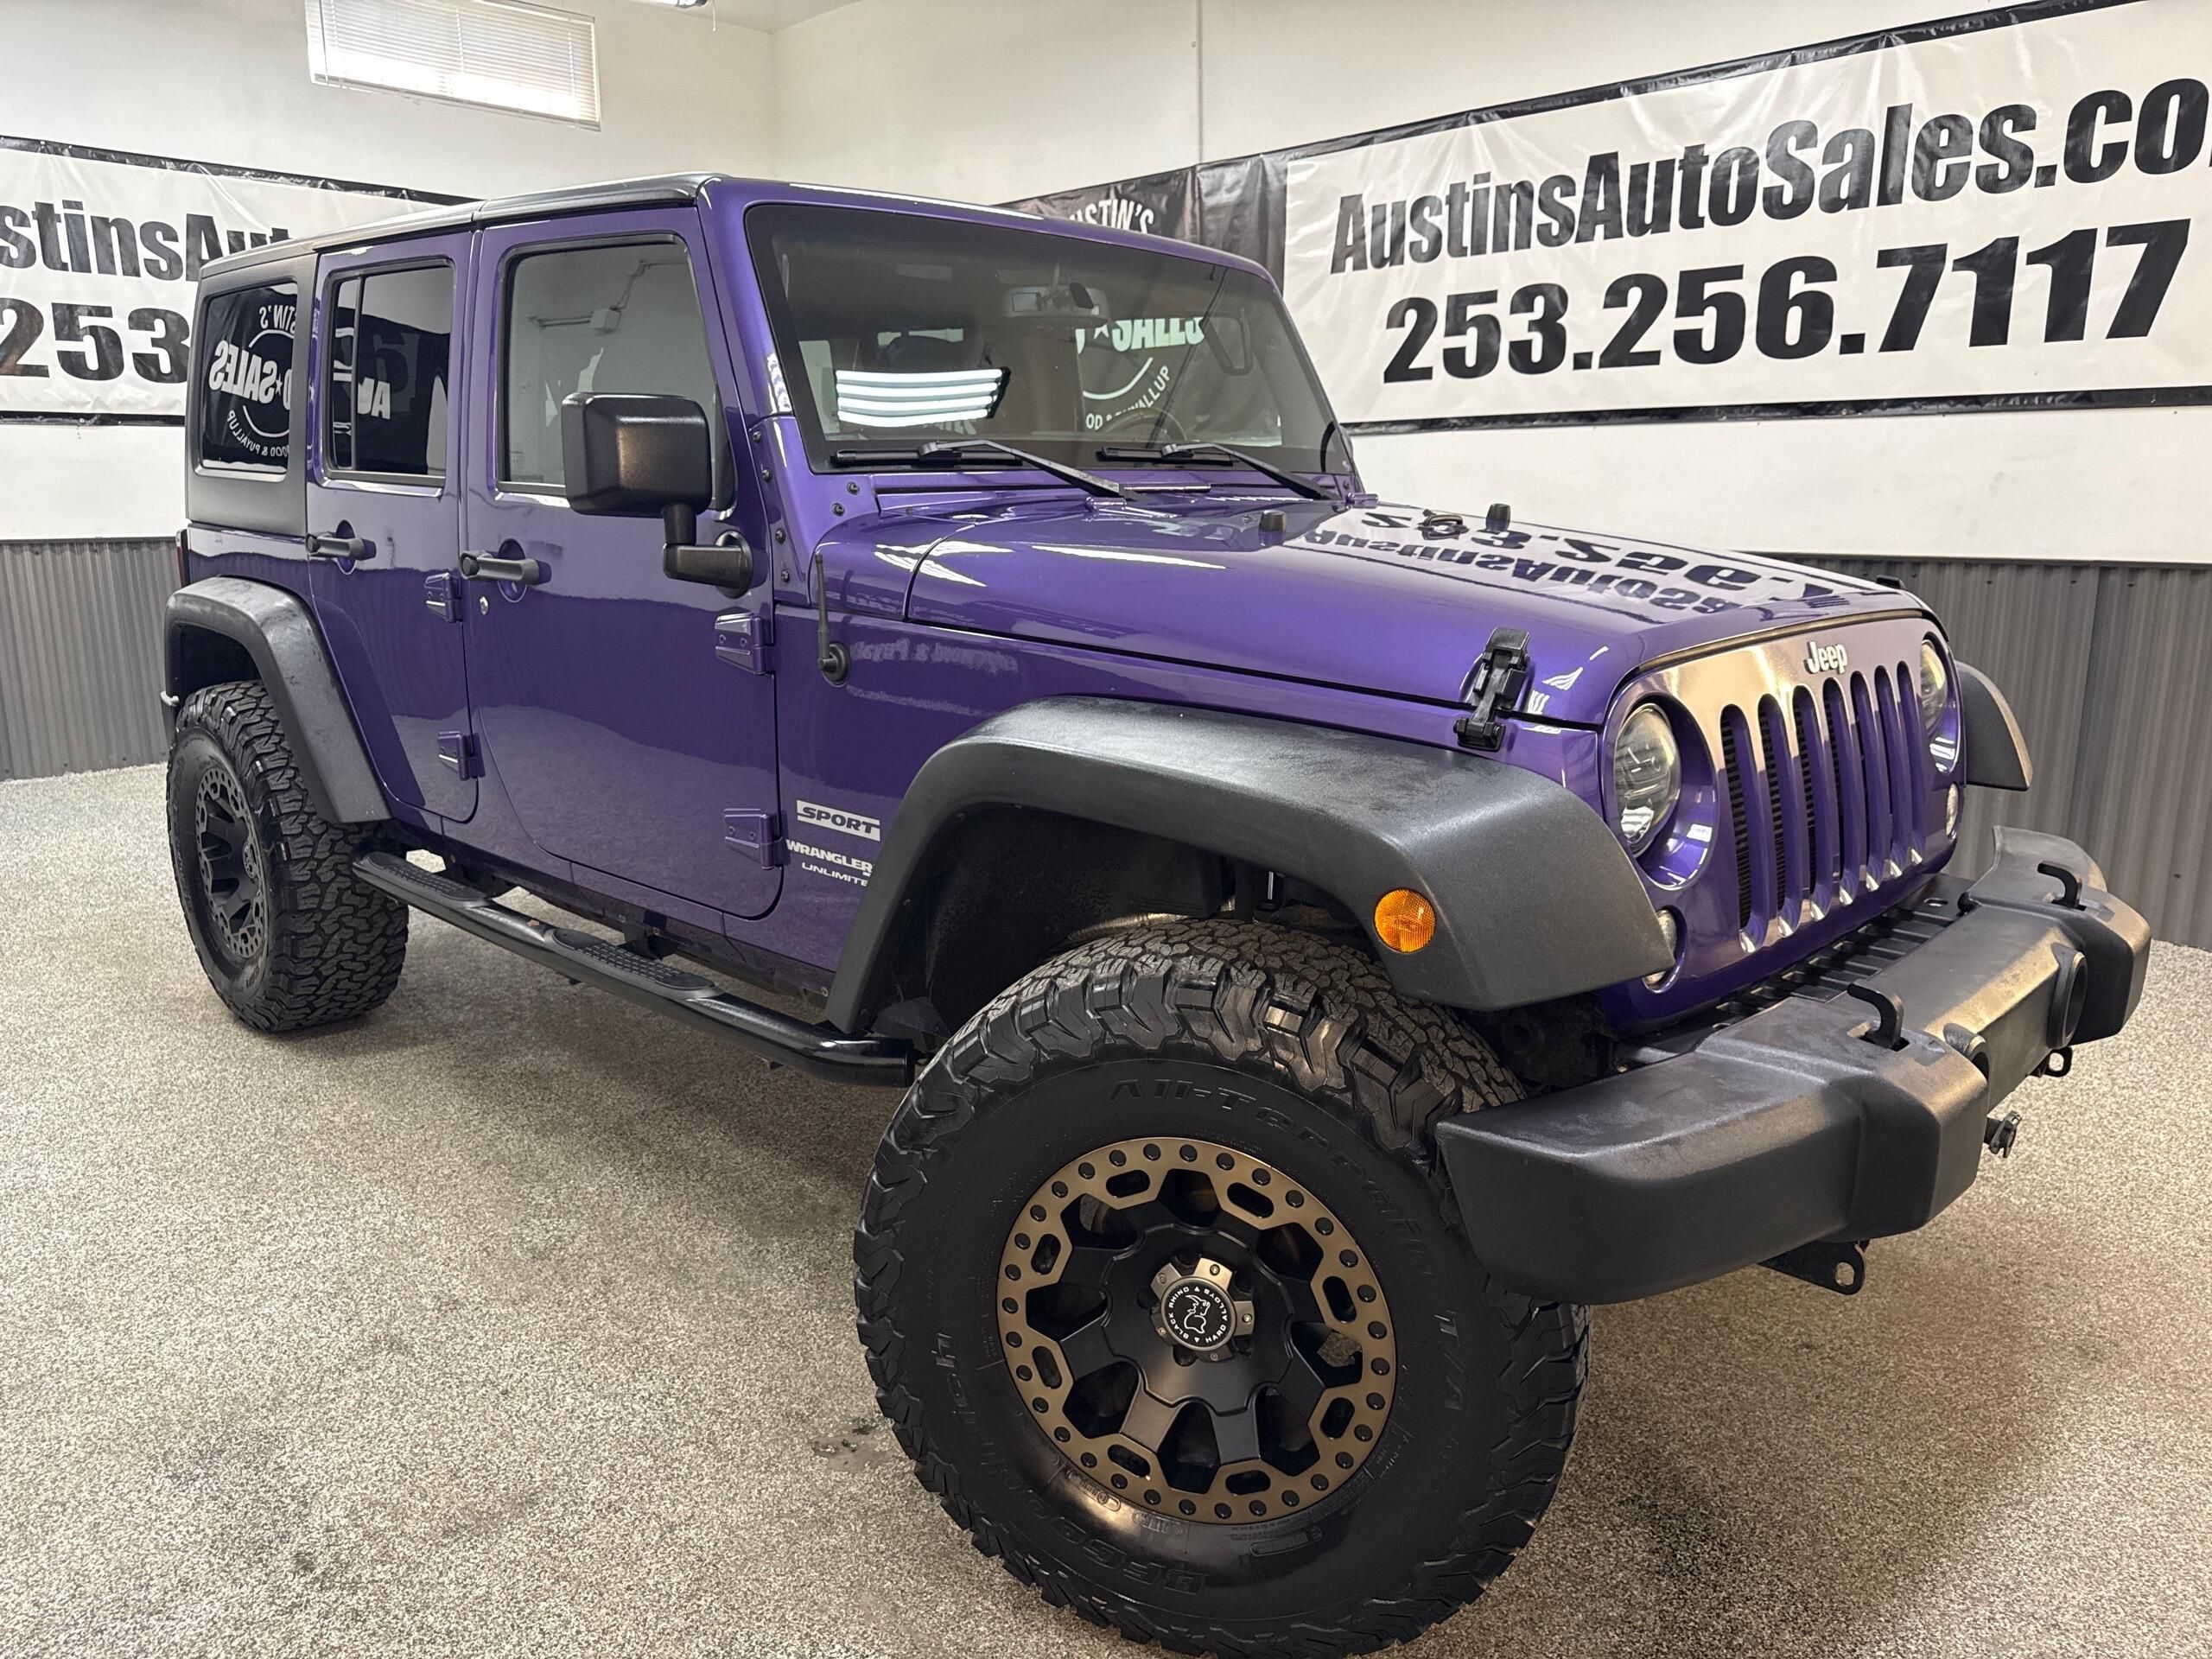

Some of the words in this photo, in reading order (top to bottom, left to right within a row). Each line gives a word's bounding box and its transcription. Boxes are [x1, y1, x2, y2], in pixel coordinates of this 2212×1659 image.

[1331, 79, 2212, 274] AustinsAutoSales.co
[1383, 219, 2190, 384] 253.256.7117
[1805, 641, 1848, 674] Jeep
[799, 806, 880, 834] SPORT
[785, 839, 873, 876] WRANGLER
